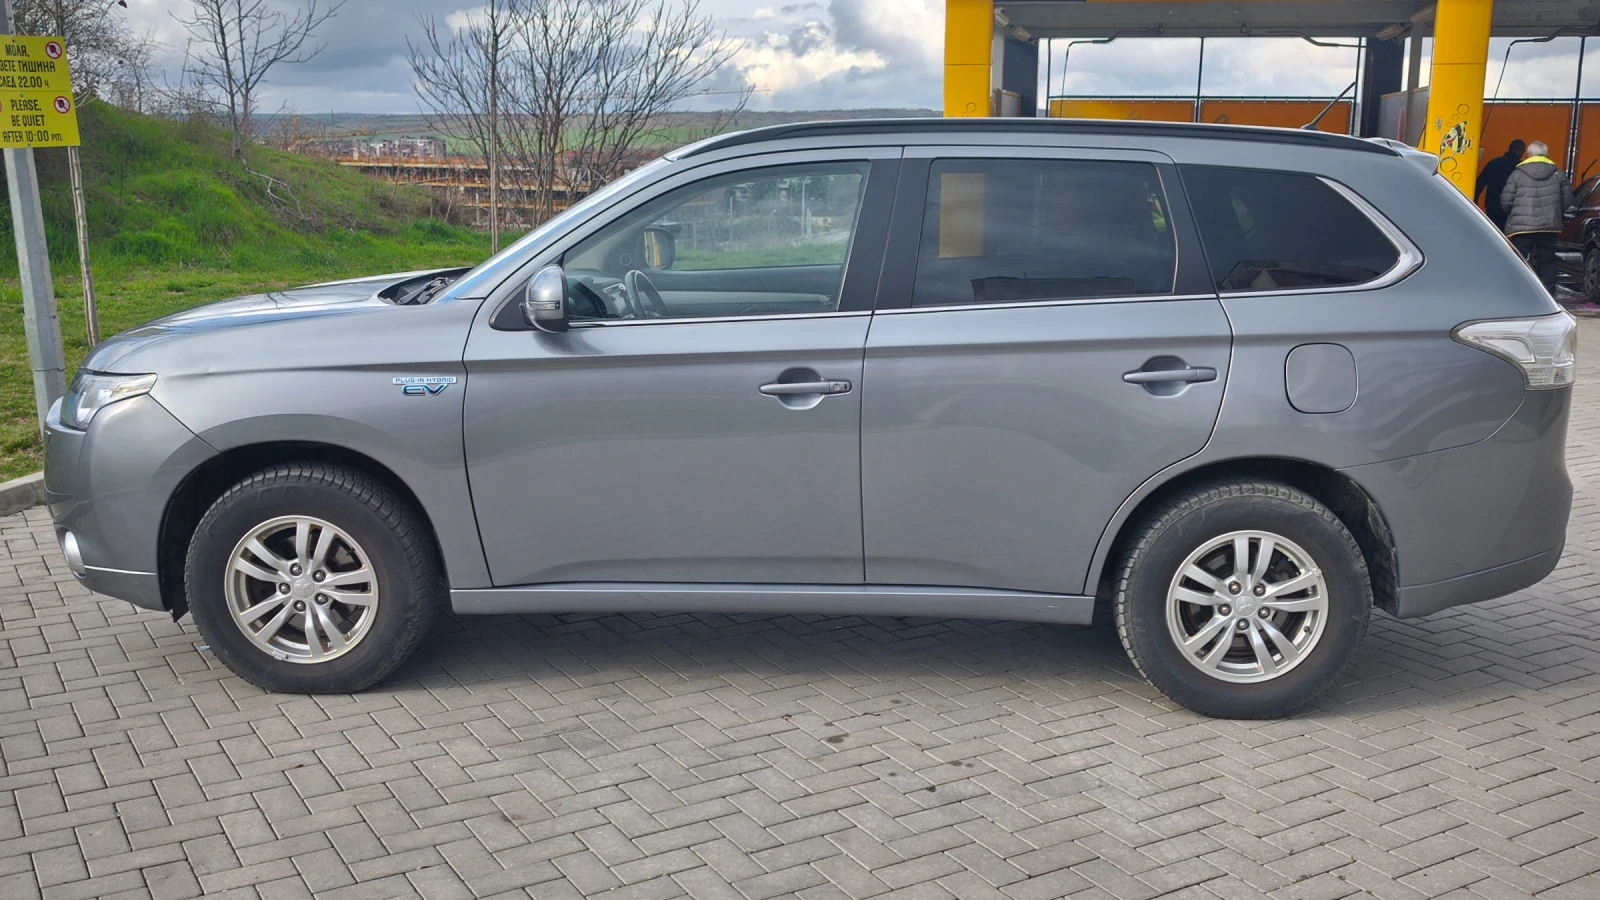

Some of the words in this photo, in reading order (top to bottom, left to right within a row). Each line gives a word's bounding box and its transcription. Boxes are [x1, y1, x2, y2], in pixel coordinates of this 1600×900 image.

[5, 44, 30, 58] МОЛЯ,
[17, 60, 56, 73] ТИШИНА
[17, 76, 43, 88] 22.00
[11, 99, 42, 112] PLEASE,
[11, 115, 21, 127] BE
[22, 114, 45, 128] QUIET
[3, 131, 24, 143] AFTER
[25, 130, 49, 142] 10:00
[402, 384, 448, 396] EV
